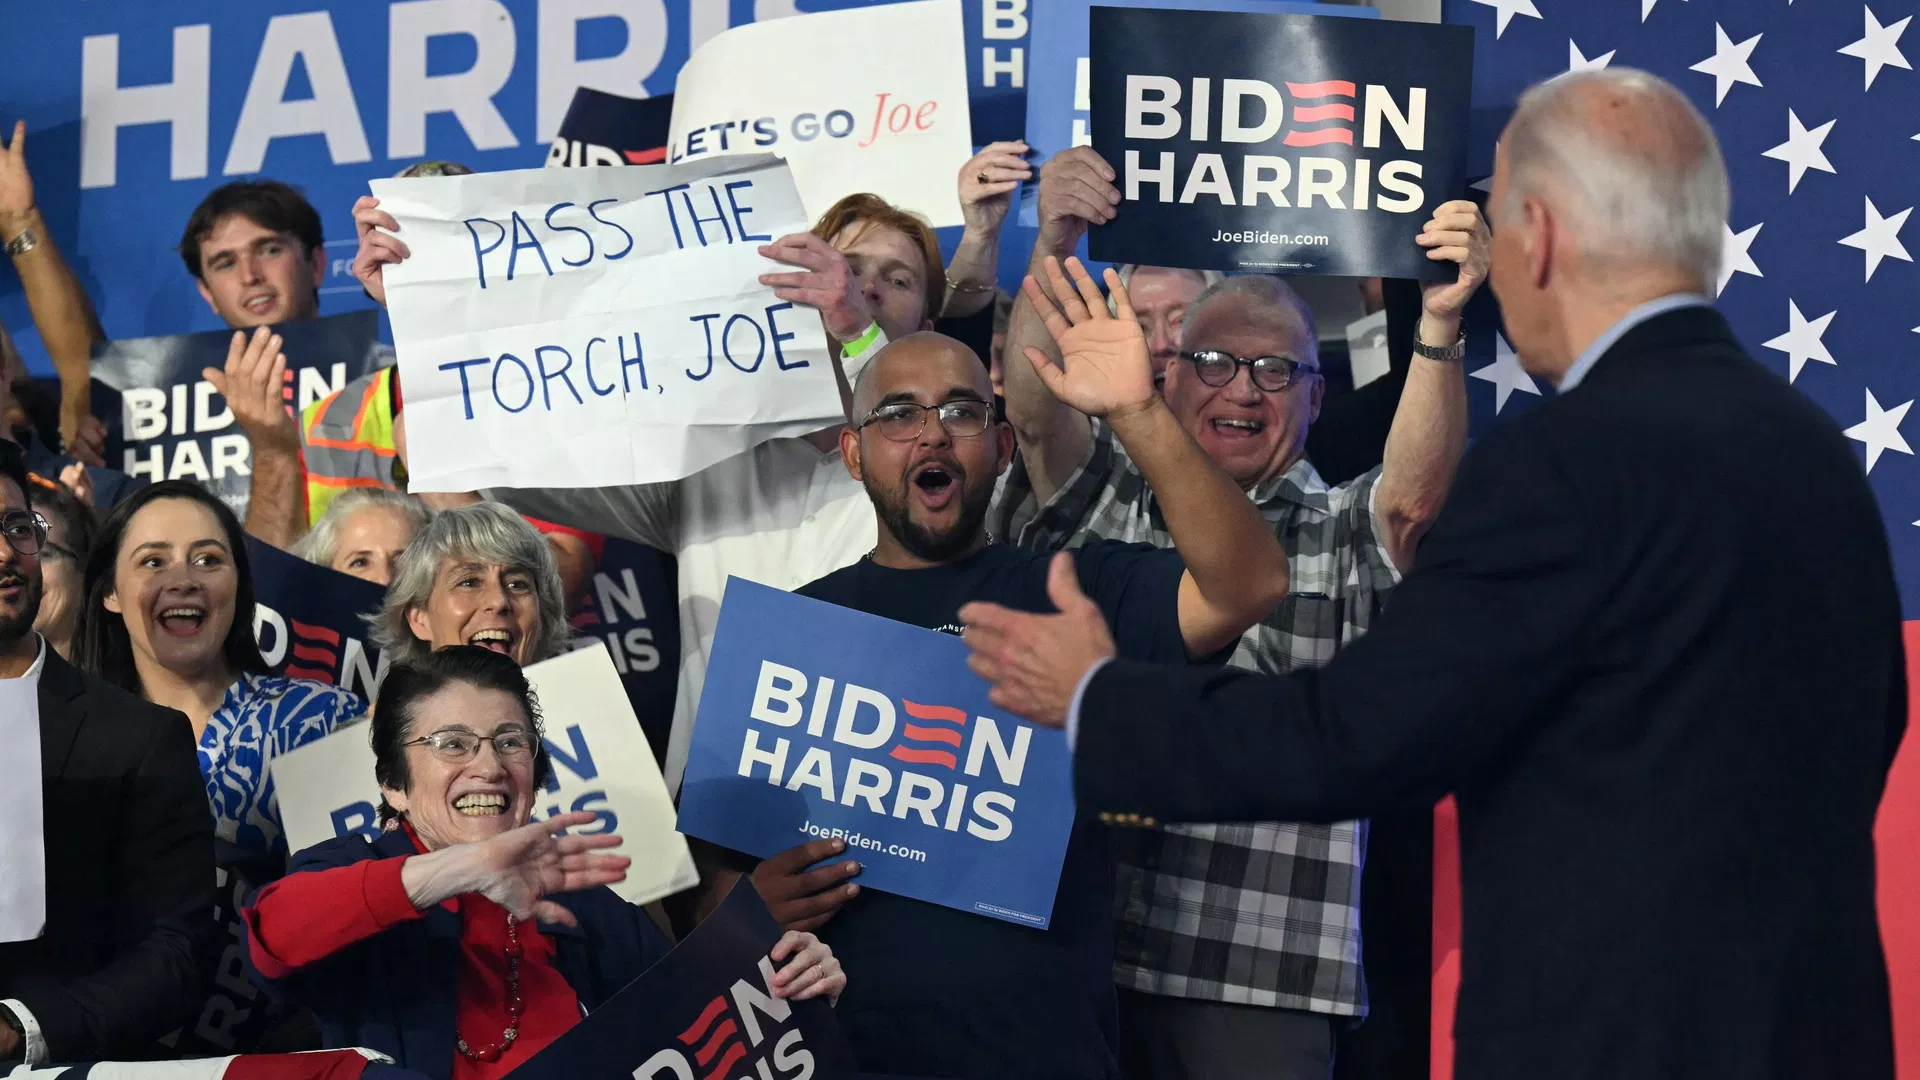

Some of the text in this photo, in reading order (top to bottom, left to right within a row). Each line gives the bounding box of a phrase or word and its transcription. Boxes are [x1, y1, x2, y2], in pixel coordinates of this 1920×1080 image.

[80, 0, 810, 189] HARR
[791, 109, 855, 141] GO
[857, 92, 938, 148] Joe
[1124, 74, 1427, 151] BIDEN
[1125, 150, 1425, 213] HARRIS
[463, 179, 772, 289] PASS THE
[1212, 230, 1329, 246] JoeBiden.com
[438, 302, 810, 420] TORCH, JOE
[122, 362, 347, 441] BIDN
[123, 433, 251, 483] HAR
[252, 602, 391, 705] DEN
[750, 659, 1033, 787] BIDEN
[736, 728, 1017, 843] HARRIS
[798, 820, 927, 862] JoeBiden.com
